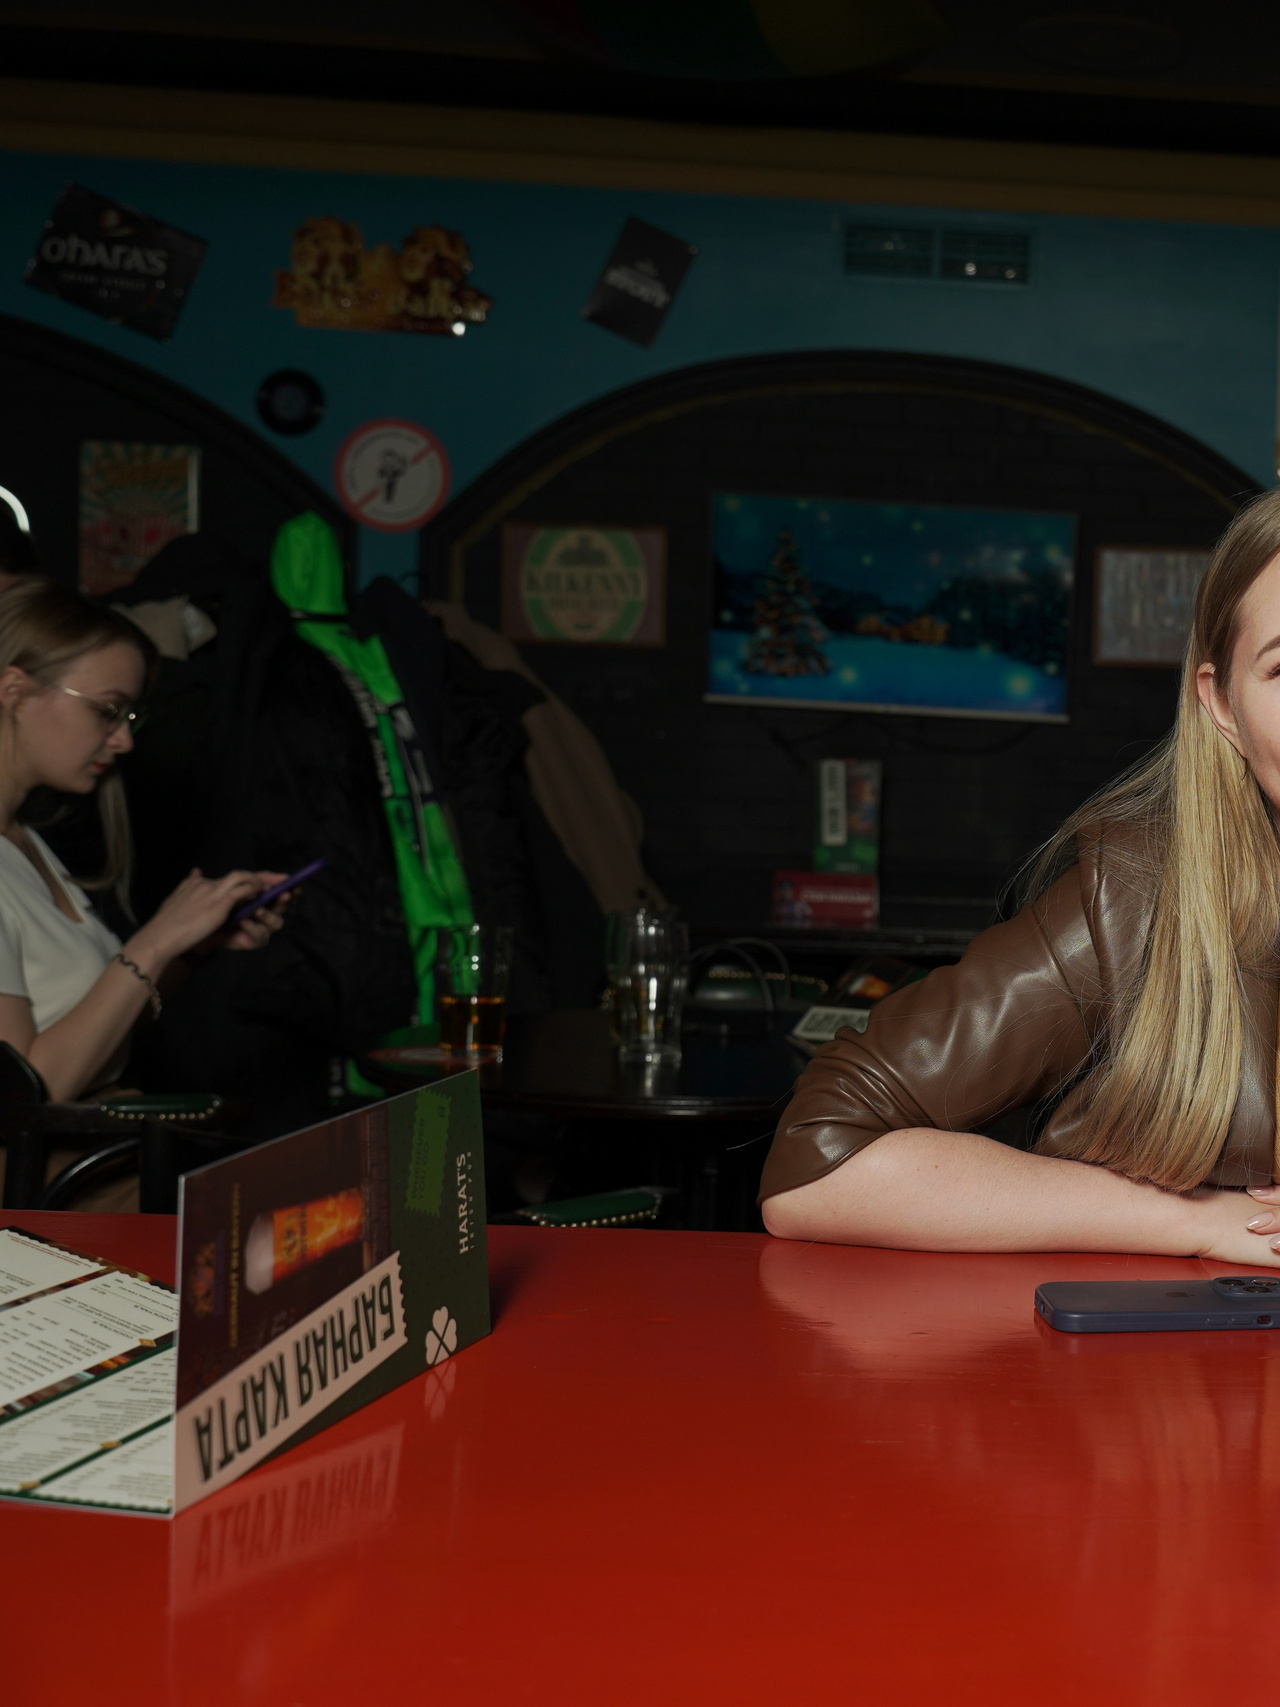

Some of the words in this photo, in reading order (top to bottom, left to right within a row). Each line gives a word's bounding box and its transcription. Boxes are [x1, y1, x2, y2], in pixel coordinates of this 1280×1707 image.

[456, 1153, 469, 1255] HARAT'S
[294, 1272, 396, 1407] БАРНАЯ
[193, 1351, 290, 1483] КАРТА
